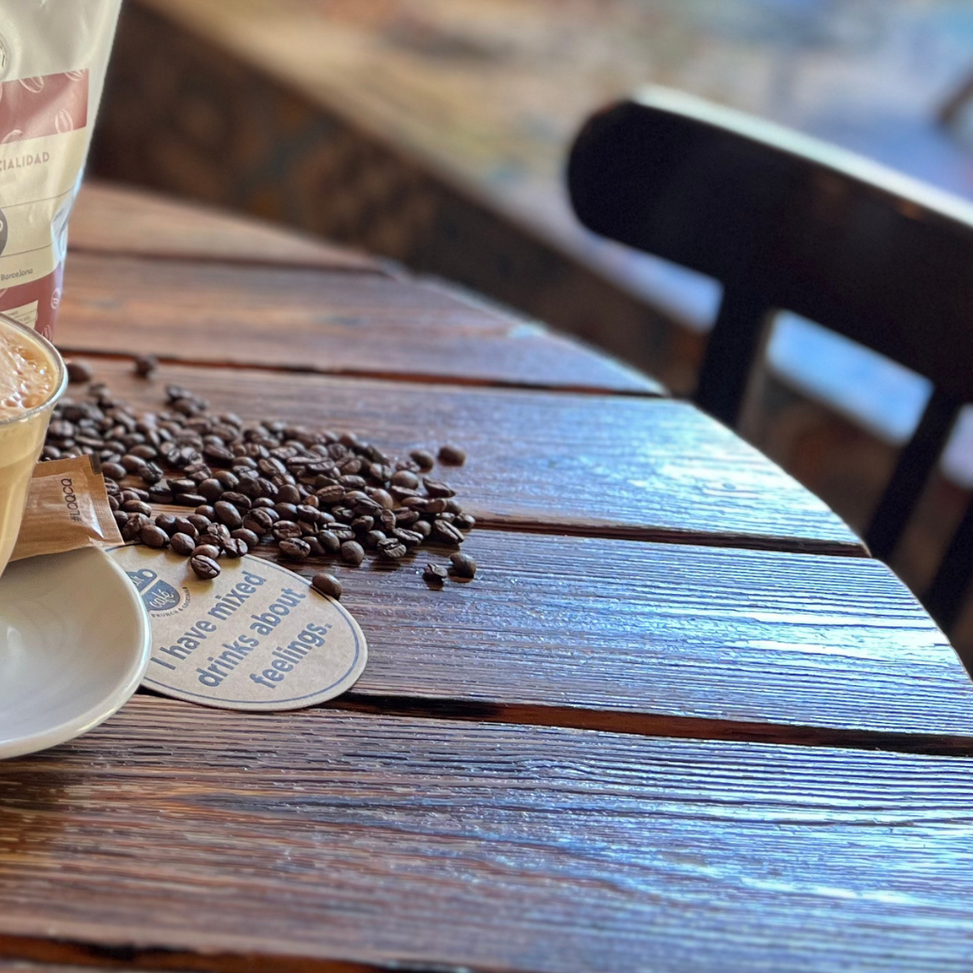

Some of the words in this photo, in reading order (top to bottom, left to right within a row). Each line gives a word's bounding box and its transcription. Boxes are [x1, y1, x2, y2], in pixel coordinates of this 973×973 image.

[0, 267, 34, 282] Barcelona
[216, 570, 267, 621] mixed
[159, 620, 217, 661] have
[198, 633, 260, 688] drinks
[249, 588, 307, 637] about
[249, 621, 333, 690] feelings.
[150, 655, 176, 671] I
